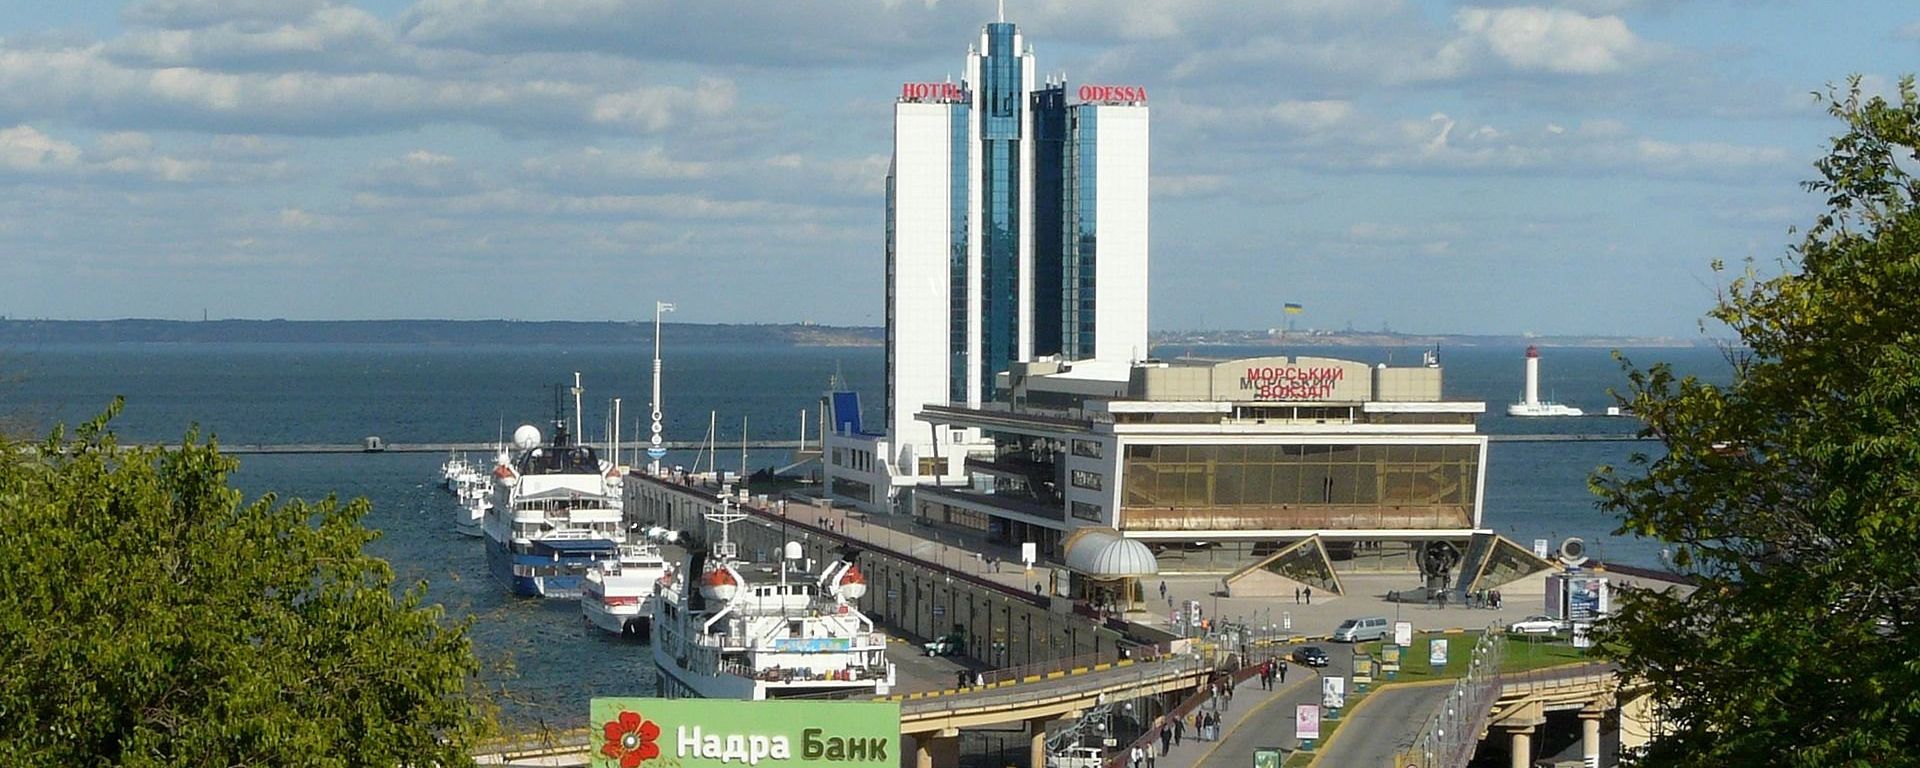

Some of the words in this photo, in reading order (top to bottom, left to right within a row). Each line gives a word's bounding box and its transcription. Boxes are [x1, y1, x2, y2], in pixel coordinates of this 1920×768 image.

[903, 83, 962, 98] HOTEL
[1079, 85, 1147, 101] ODESSA
[1247, 366, 1344, 380] МОРСЬКИЙ
[1260, 385, 1331, 398] ВОКЗАЛ
[677, 725, 790, 765] Надра
[802, 728, 888, 761] Банк
